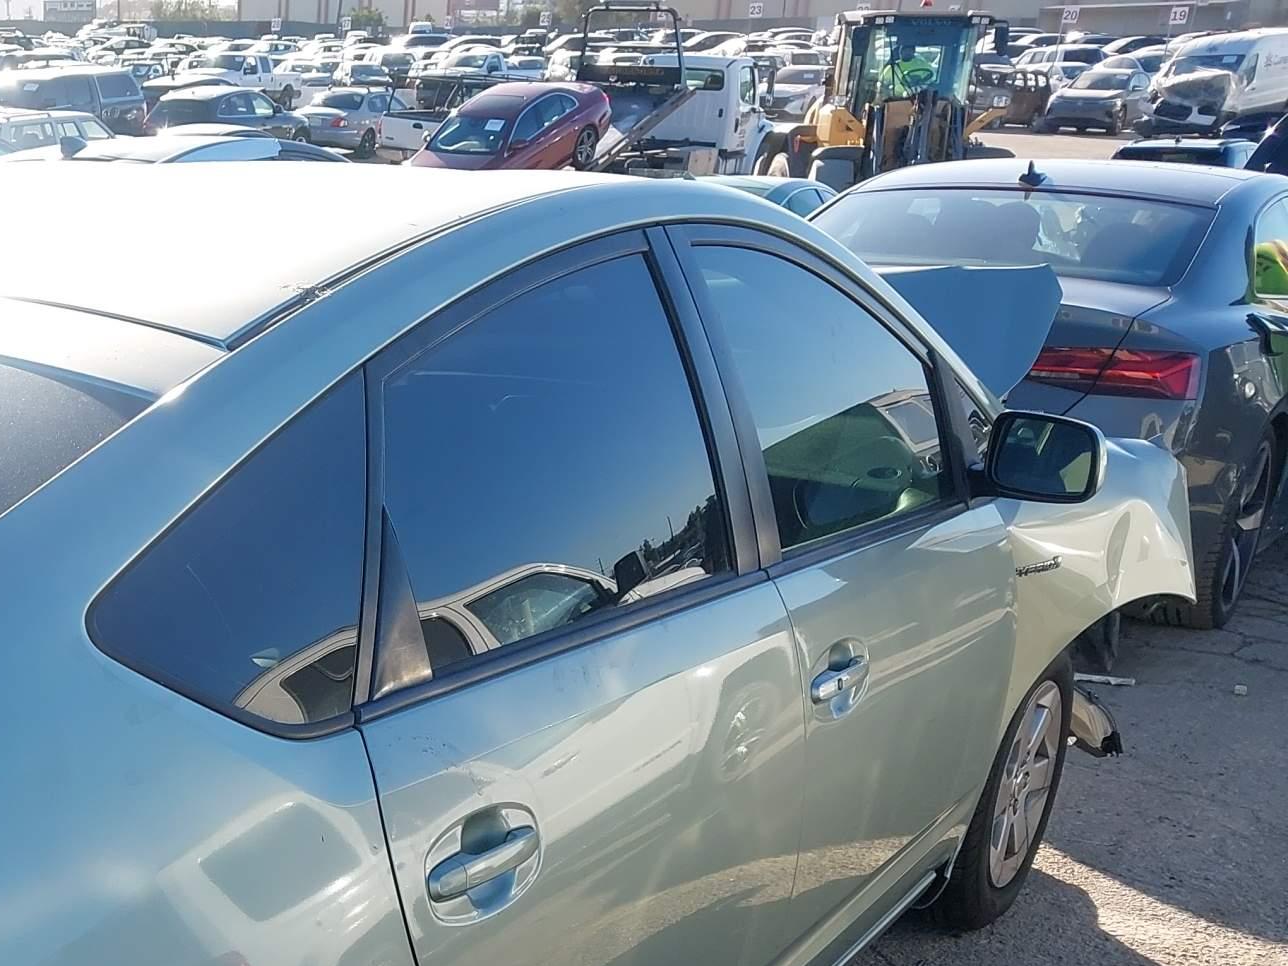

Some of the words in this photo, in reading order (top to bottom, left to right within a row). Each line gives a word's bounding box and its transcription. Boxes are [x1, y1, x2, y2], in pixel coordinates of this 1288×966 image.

[749, 5, 762, 15] 23
[1063, 10, 1078, 21] 20
[1171, 9, 1187, 21] 19
